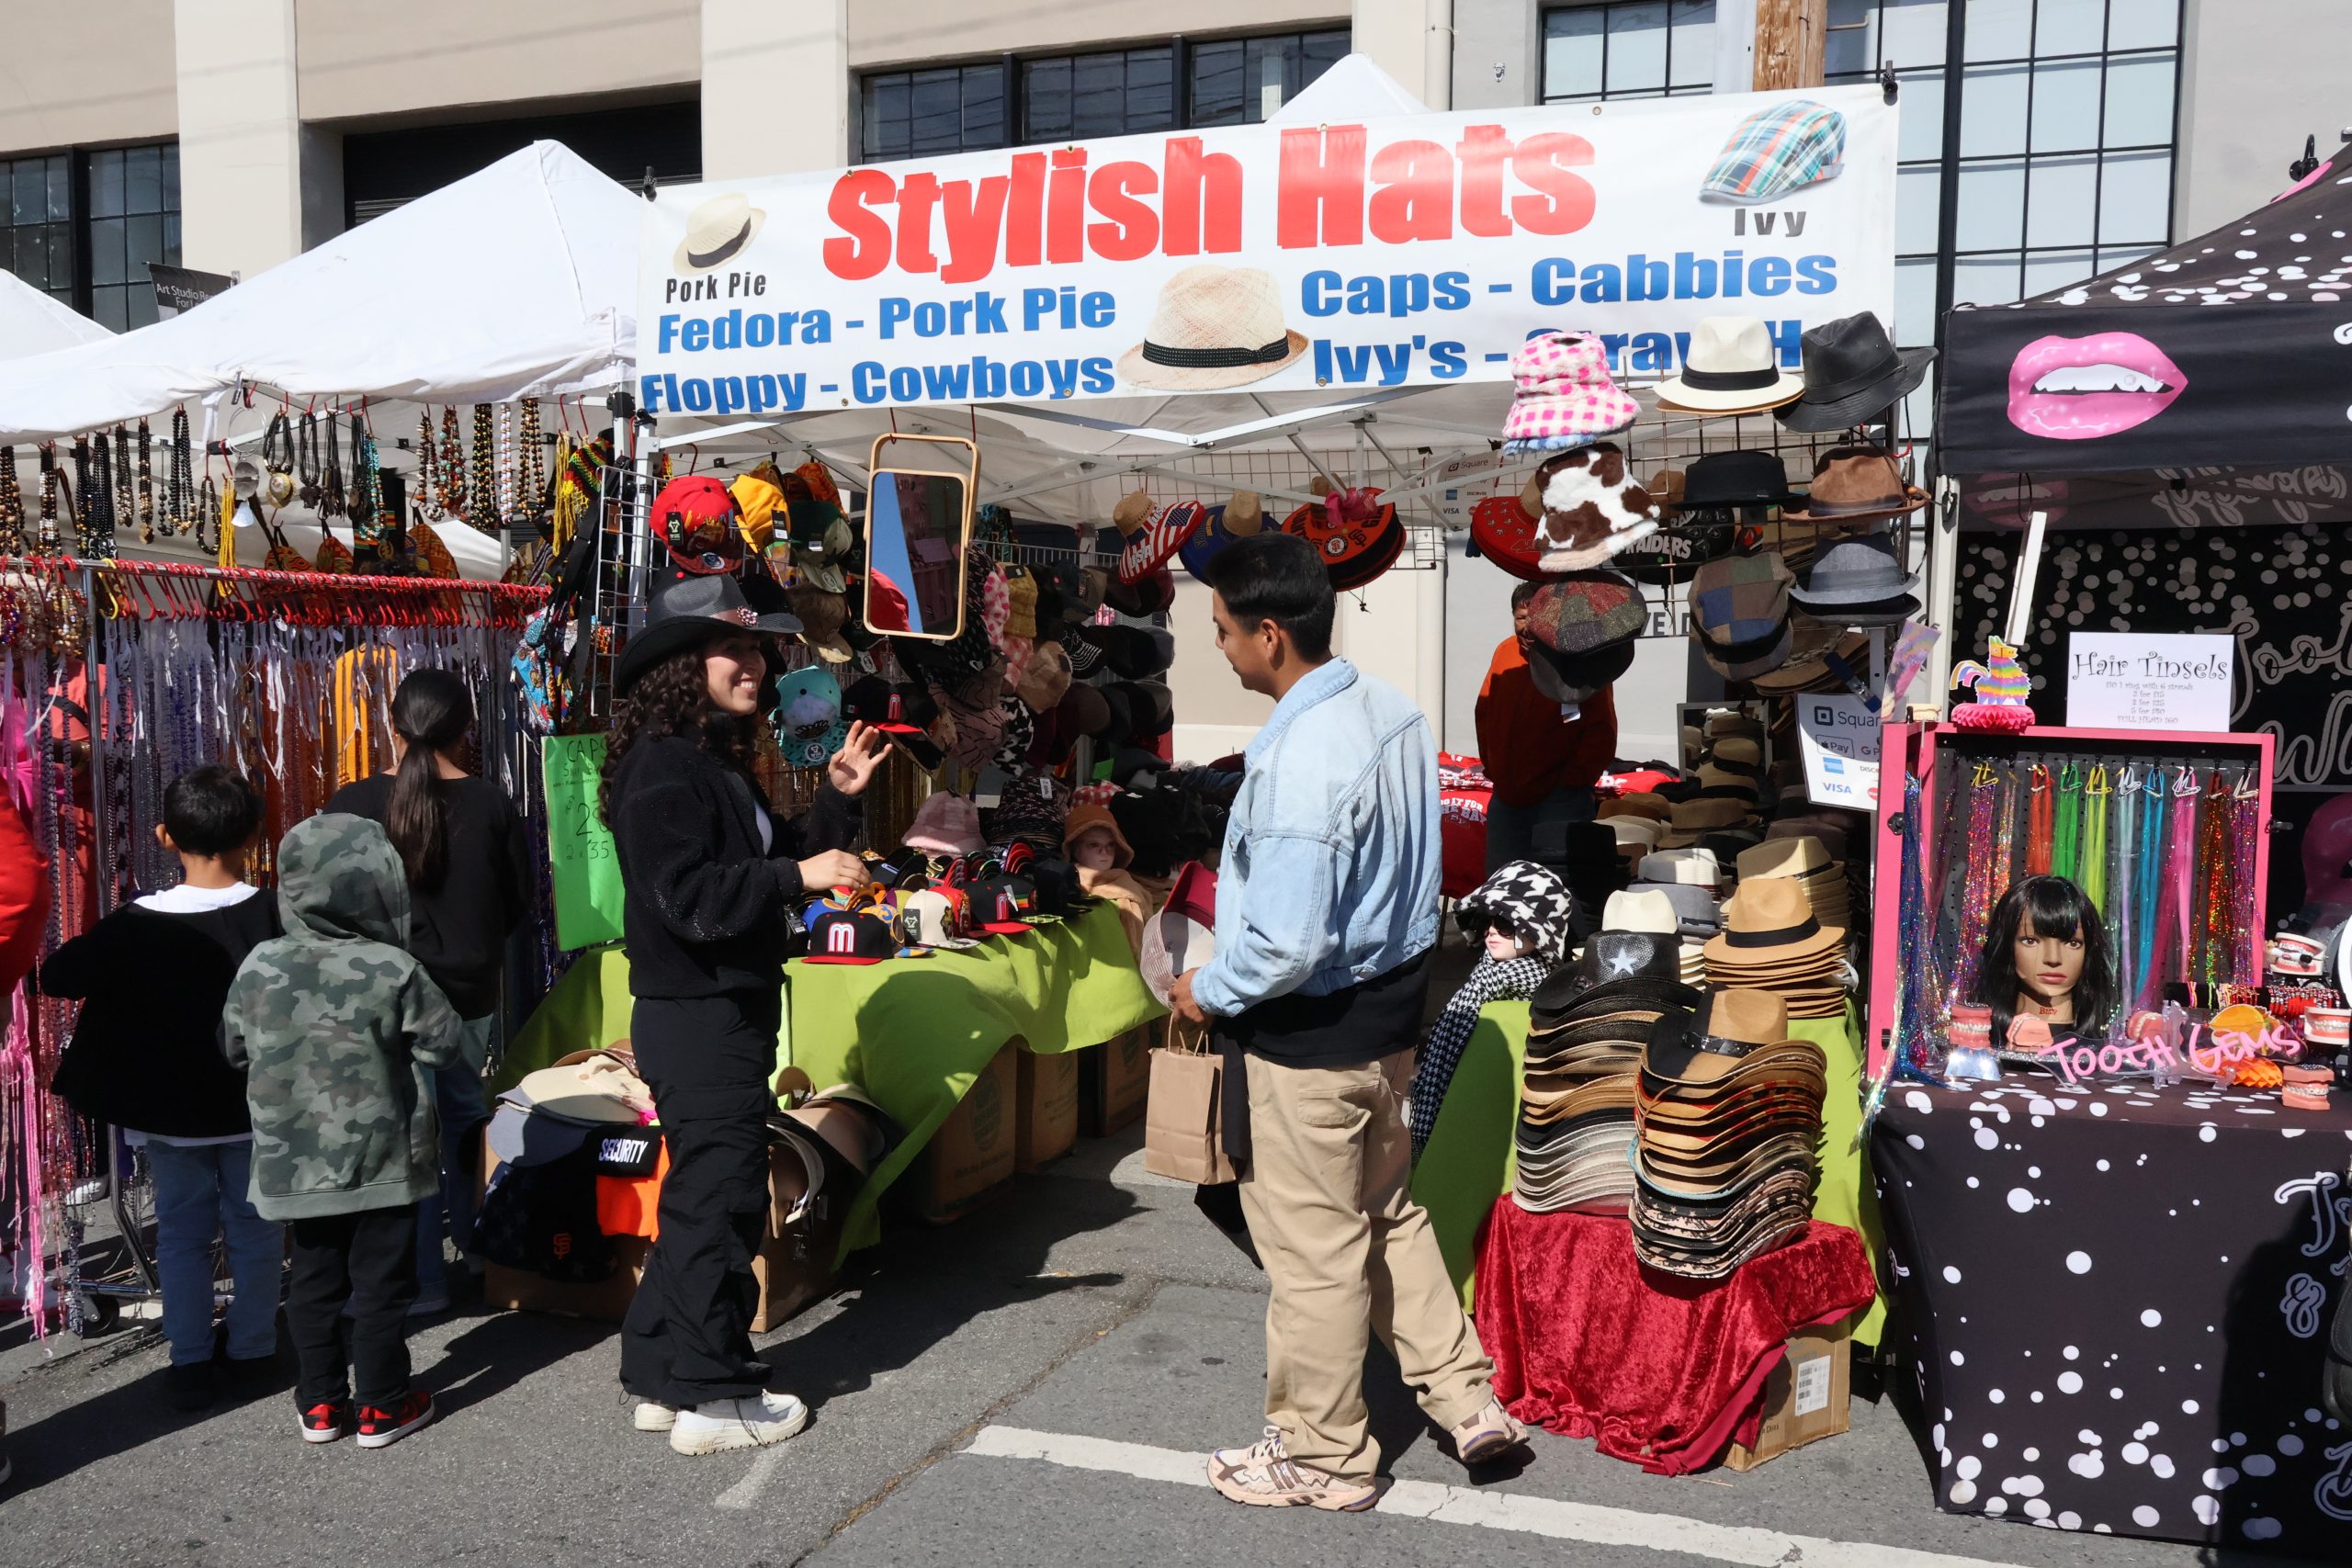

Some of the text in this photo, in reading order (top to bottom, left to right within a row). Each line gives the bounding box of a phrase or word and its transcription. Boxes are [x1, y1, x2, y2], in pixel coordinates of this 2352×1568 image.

[823, 124, 1595, 284] Stylish Hats
[1734, 208, 1806, 238] Ivy
[156, 283, 171, 295] Art
[171, 286, 198, 300] Studio
[665, 271, 767, 305] Pork Pie
[1302, 270, 1472, 318] Caps
[1532, 249, 1837, 306] Cabbies
[175, 297, 189, 309] For
[659, 309, 831, 355] Fedora
[879, 290, 1008, 340] Pork
[1023, 286, 1115, 332] Pie
[1313, 334, 1467, 388] Ivy's
[640, 373, 807, 413] Floppy
[852, 355, 1115, 404] Cowboys
[1461, 459, 1488, 469] Square
[2072, 650, 2228, 681] Hair Tinsels
[1838, 711, 1881, 729] Squar
[1830, 742, 1849, 753] Pay
[1822, 782, 1853, 795] VISA
[1451, 797, 1464, 807] IT
[1464, 798, 1484, 813] FOR
[1461, 807, 1487, 825] BAY
[2037, 1022, 2301, 1086] TOOTH GEMS
[598, 1137, 649, 1164] SECURITY
